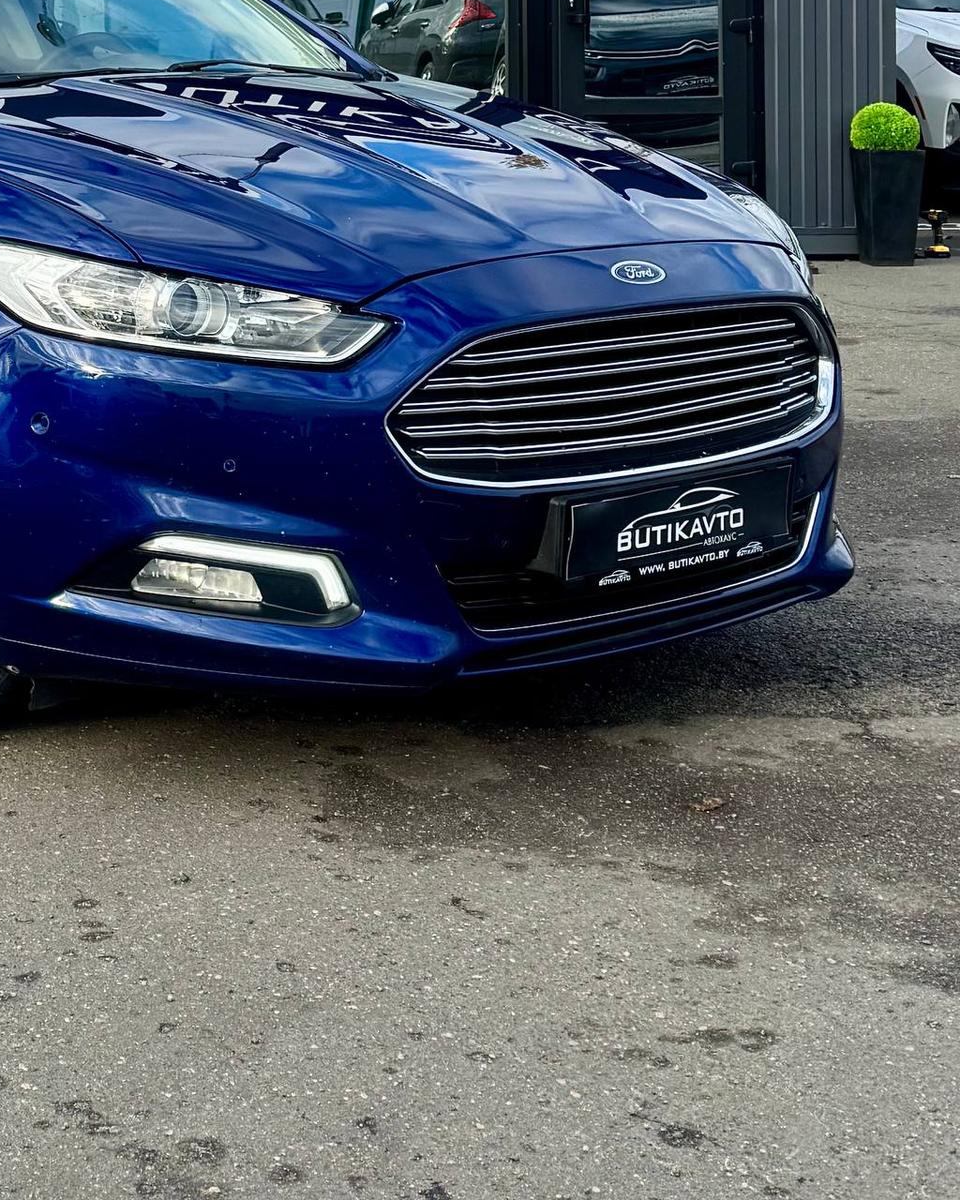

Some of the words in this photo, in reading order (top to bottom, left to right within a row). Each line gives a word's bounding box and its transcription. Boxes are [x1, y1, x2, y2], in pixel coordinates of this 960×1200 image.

[624, 265, 654, 279] Ford
[617, 508, 744, 552] BUTIKAVTO
[703, 532, 737, 546] АВТОХАУС
[668, 549, 730, 571] BUTIKAVTO.BY
